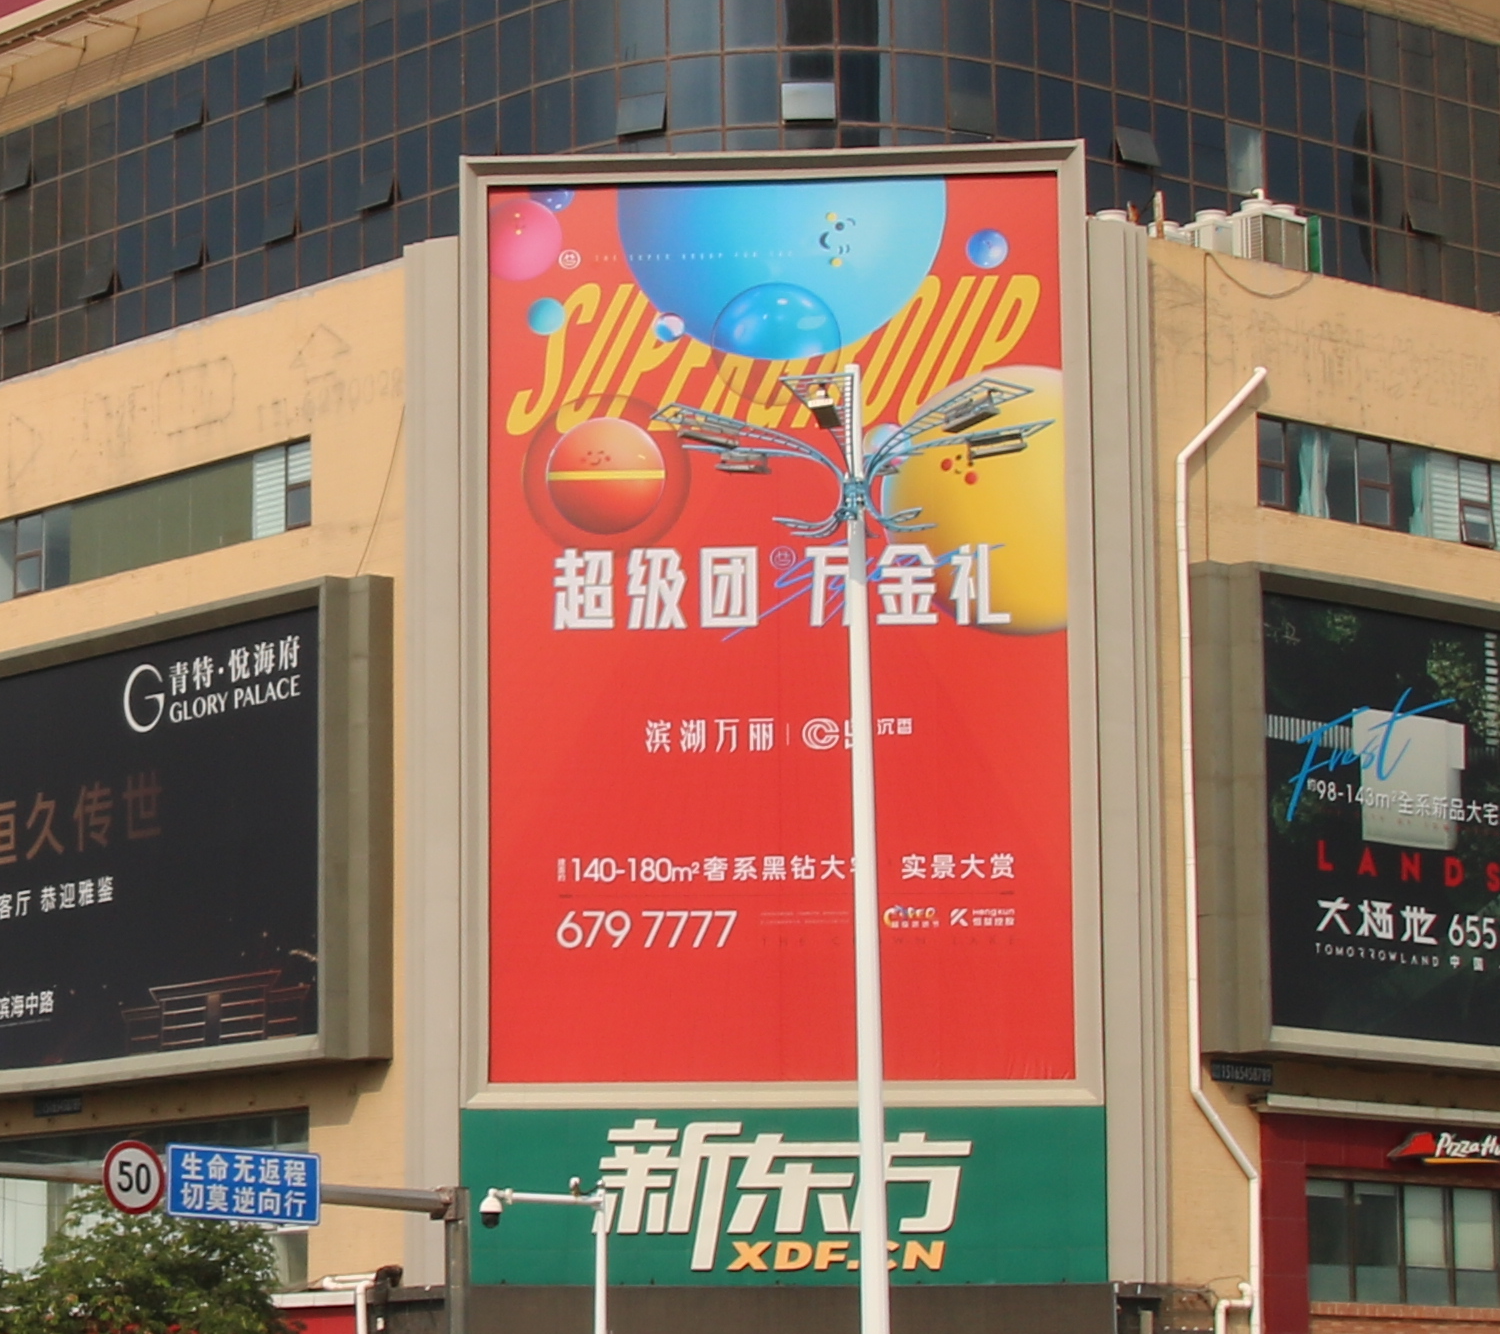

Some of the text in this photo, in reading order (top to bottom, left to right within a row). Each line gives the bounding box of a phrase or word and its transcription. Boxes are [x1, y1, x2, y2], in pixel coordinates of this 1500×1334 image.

[553, 542, 1011, 632] 超级团 万金礼
[167, 633, 302, 697] 青特·悦海府
[169, 674, 302, 724] GLORY PALACE
[644, 716, 775, 754] 滨湖万丽
[901, 852, 1015, 880] 实景大赏
[39, 875, 115, 914] 恭迎雅鉴
[555, 909, 738, 950] 679 7777
[1435, 1131, 1481, 1158] Pizza
[116, 1160, 152, 1196] 50
[180, 1151, 308, 1188] 生命无返程
[180, 1183, 308, 1218] 切莫逆向行
[589, 1118, 973, 1272] 新东方
[726, 1239, 945, 1272] XDF.CN
